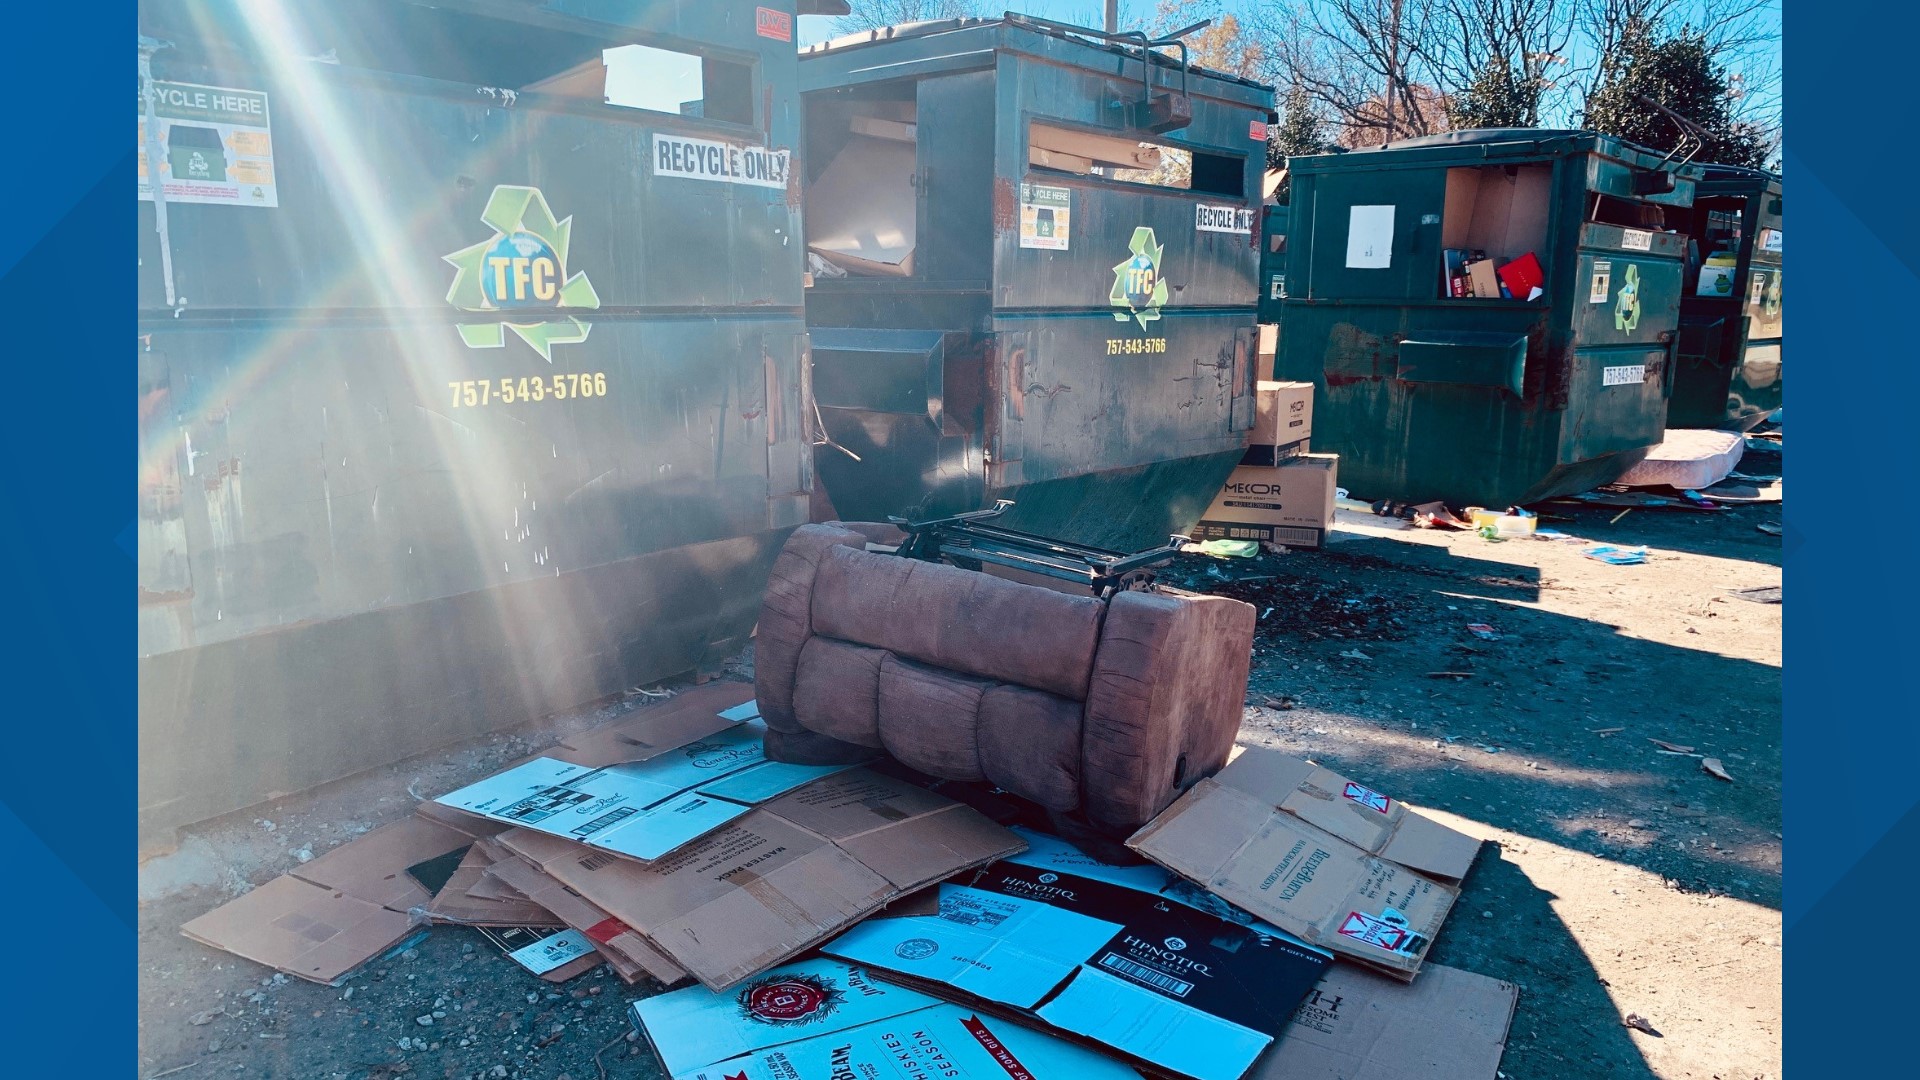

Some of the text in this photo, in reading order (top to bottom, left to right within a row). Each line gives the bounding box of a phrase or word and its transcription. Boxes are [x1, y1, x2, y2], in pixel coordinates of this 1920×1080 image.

[138, 87, 262, 114] YCLE HERE
[658, 140, 786, 183] RECYCLE ONLY
[1052, 192, 1068, 200] HERE
[1197, 207, 1232, 228] RECYCLE
[489, 257, 556, 301] TFC
[1129, 269, 1153, 295] TFC
[1107, 338, 1166, 355] 757-543-5766
[448, 372, 607, 408] 757-543-5766
[1224, 483, 1281, 495] MECOR
[692, 755, 730, 768] Crown
[723, 743, 760, 759] Royal
[714, 846, 786, 882] MASTER PACK
[1002, 876, 1078, 901] HPNOTIQ
[1005, 885, 1029, 895] GIFT
[1033, 890, 1055, 899] SETS
[1123, 935, 1214, 978] HPNOTIQ
[1130, 948, 1157, 961] GIFT
[1162, 960, 1188, 973] SETS
[1286, 949, 1305, 958] GIFT
[1306, 955, 1322, 964] SETS
[859, 984, 886, 997] JIM
[1302, 1004, 1340, 1020] ESOME
[910, 1044, 924, 1059] THE
[976, 1029, 998, 1049] GIFTS
[881, 1033, 928, 1080] HISKIES
[912, 1030, 959, 1077] SEASON
[998, 1050, 1017, 1069] 50ML
